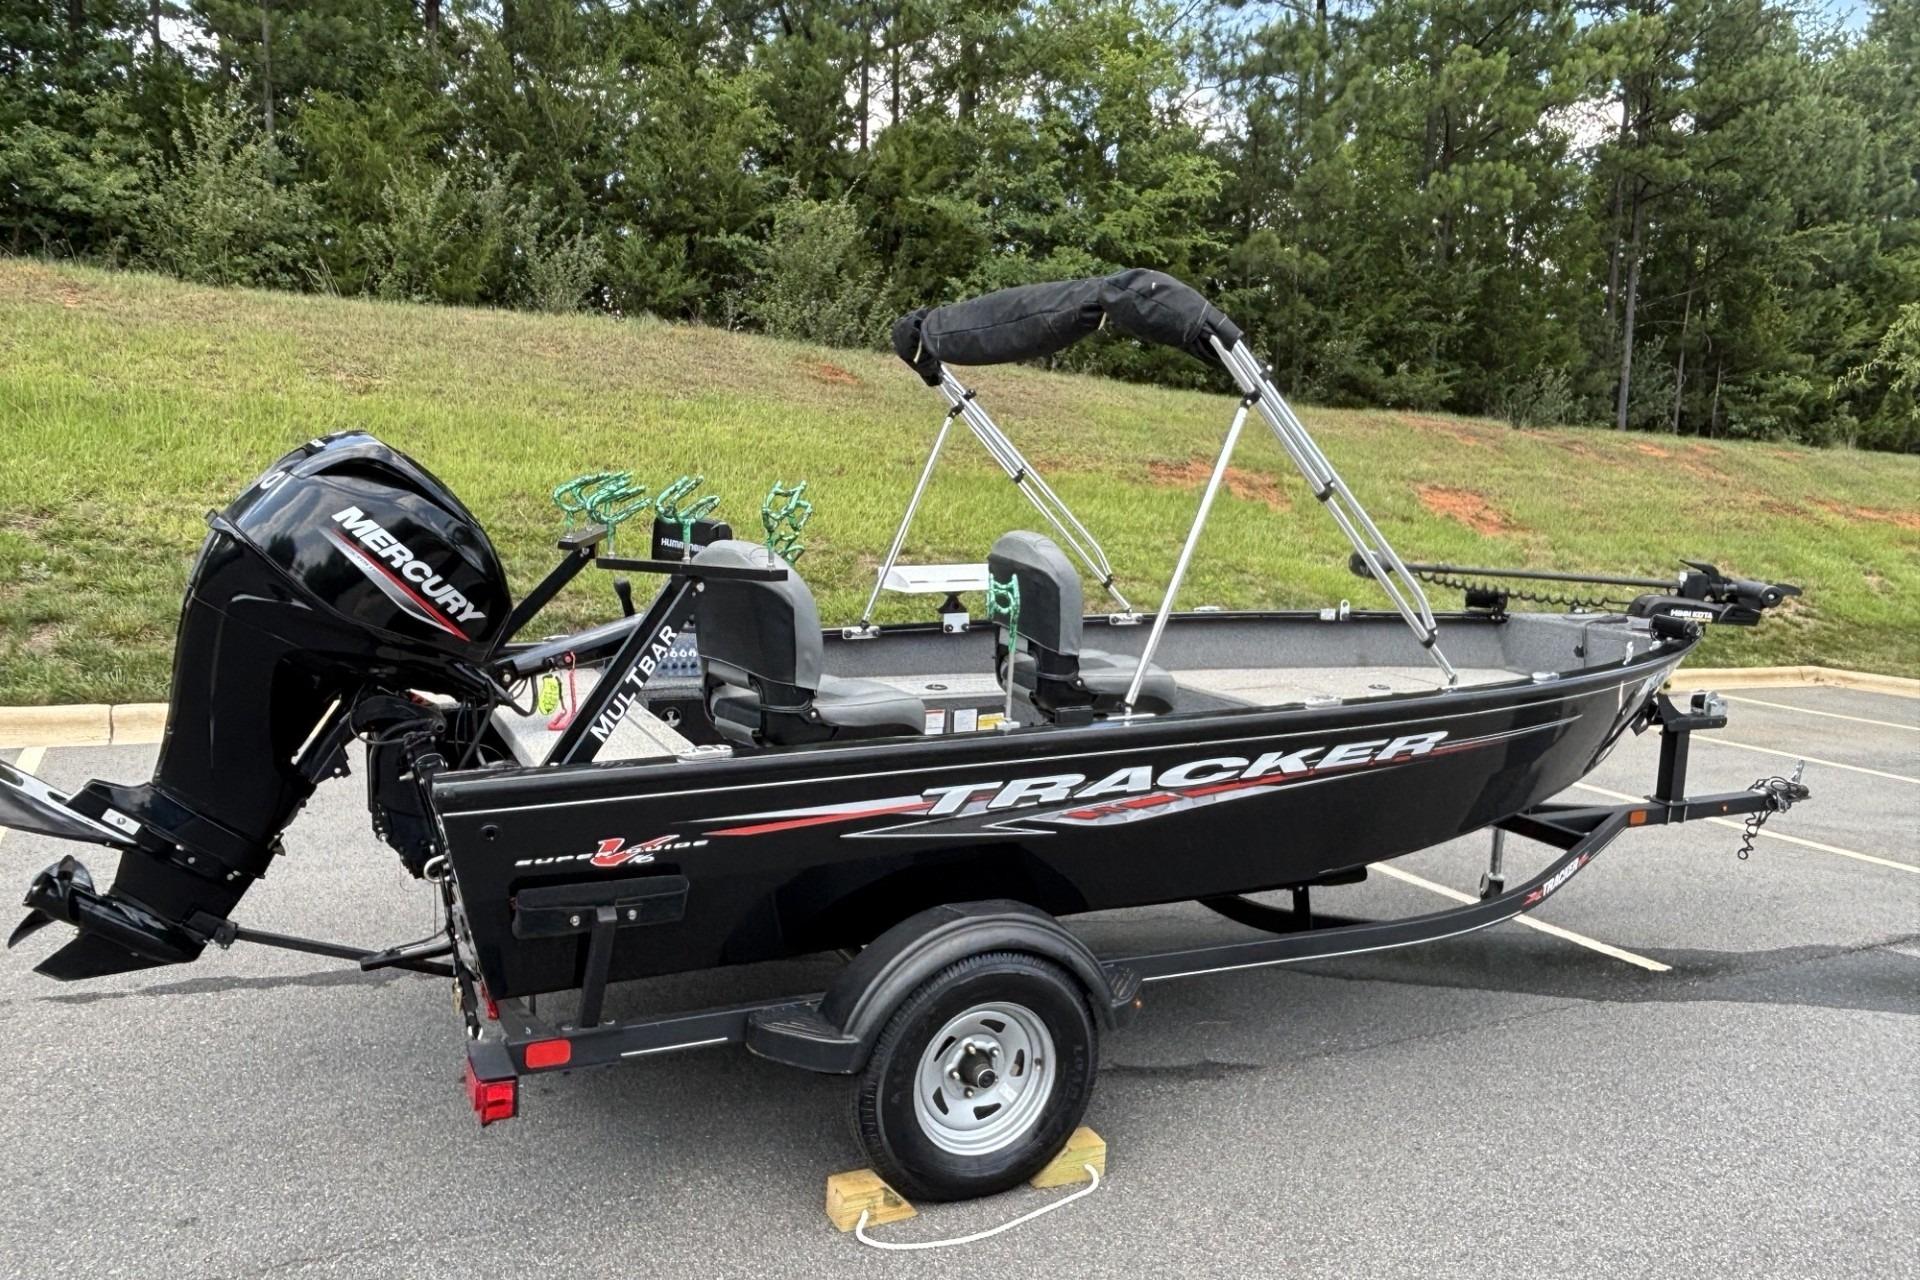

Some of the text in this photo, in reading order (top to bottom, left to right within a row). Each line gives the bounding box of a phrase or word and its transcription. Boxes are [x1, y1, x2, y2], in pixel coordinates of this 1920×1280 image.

[331, 505, 487, 623] MERCURY
[921, 730, 1450, 816] TRACKER
[1542, 856, 1580, 897] TRACKER
